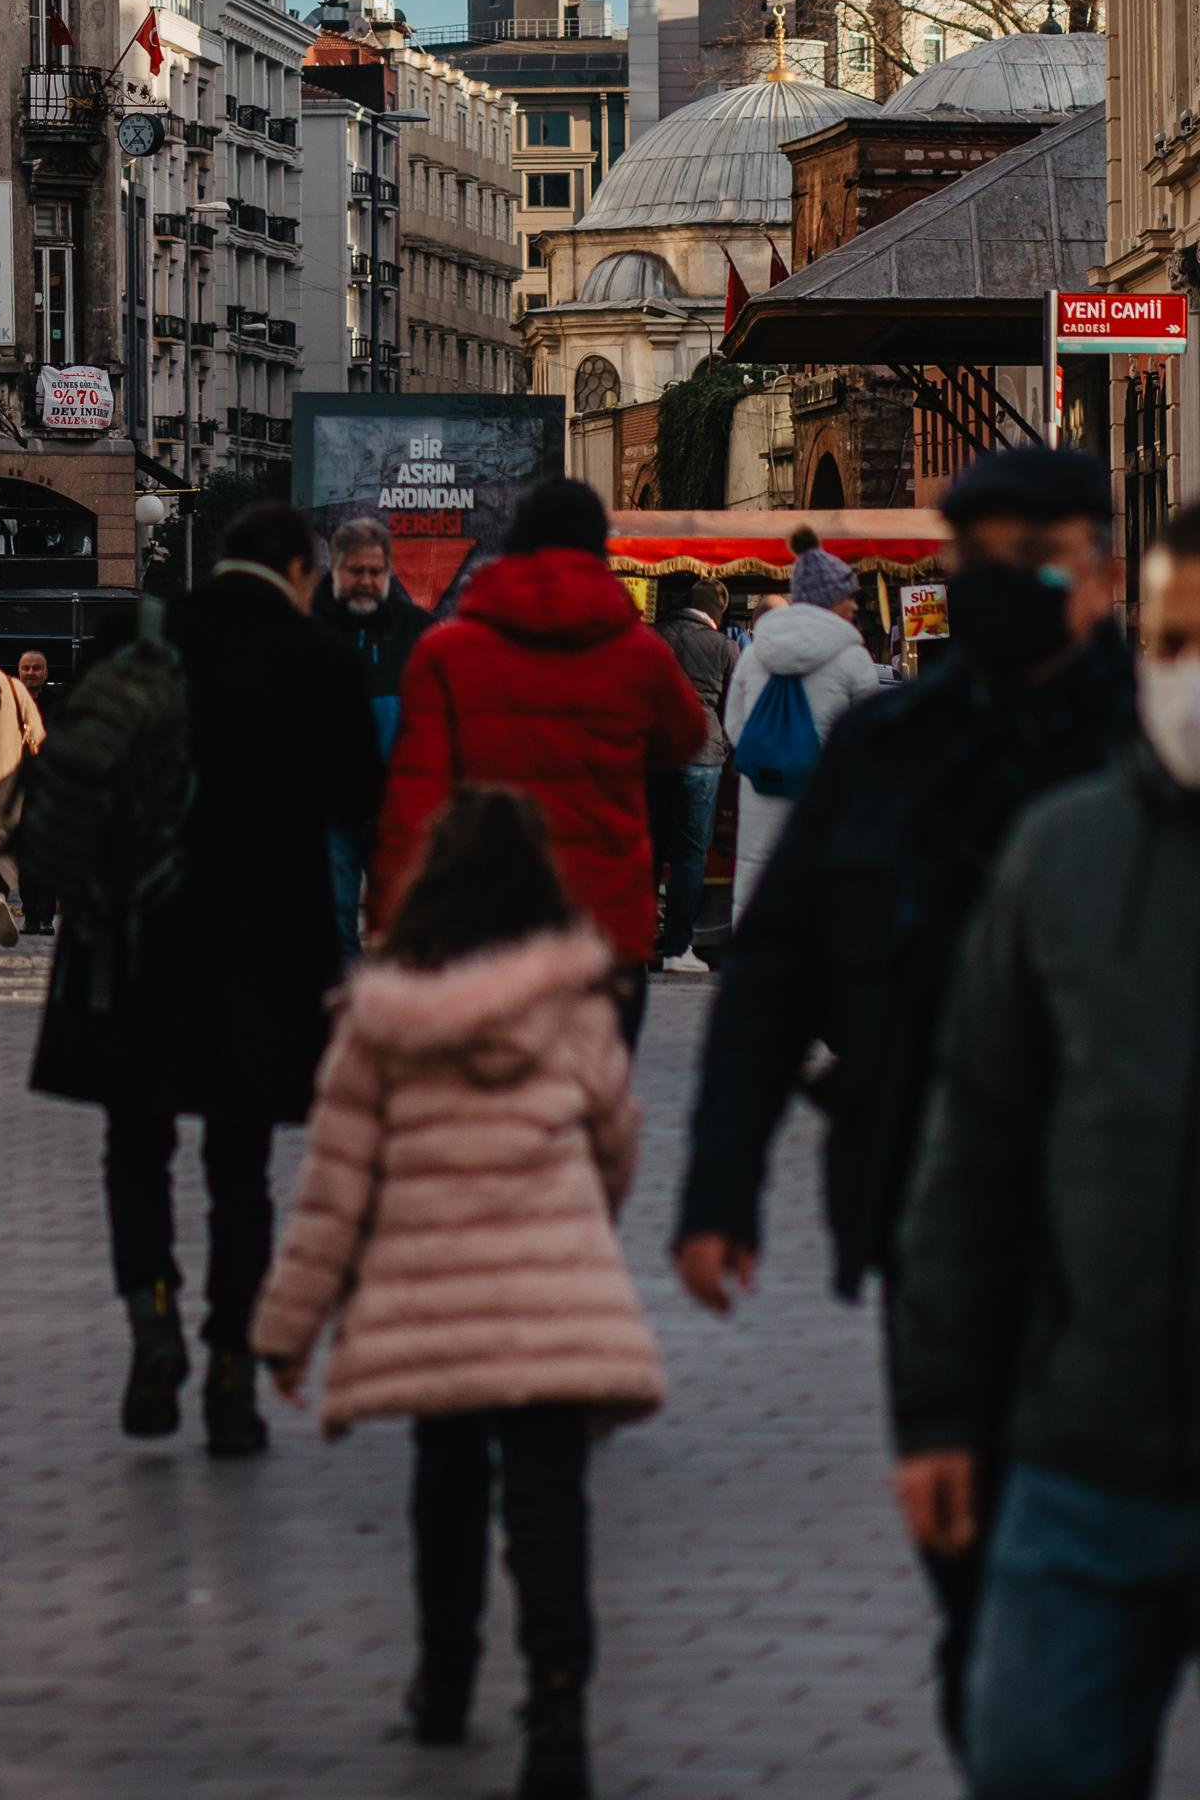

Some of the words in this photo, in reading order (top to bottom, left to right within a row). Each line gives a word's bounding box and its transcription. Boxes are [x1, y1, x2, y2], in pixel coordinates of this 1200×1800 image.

[1063, 299, 1106, 319] YENİ
[1111, 300, 1162, 319] CAMİİ
[1063, 322, 1110, 333] CADDESİ
[51, 407, 77, 416] DEV
[409, 433, 443, 459] BİR
[397, 463, 455, 484] ASRIN
[378, 488, 474, 509] ARDINDAN
[389, 510, 462, 535] SERGİSİ
[911, 589, 936, 603] SÜT
